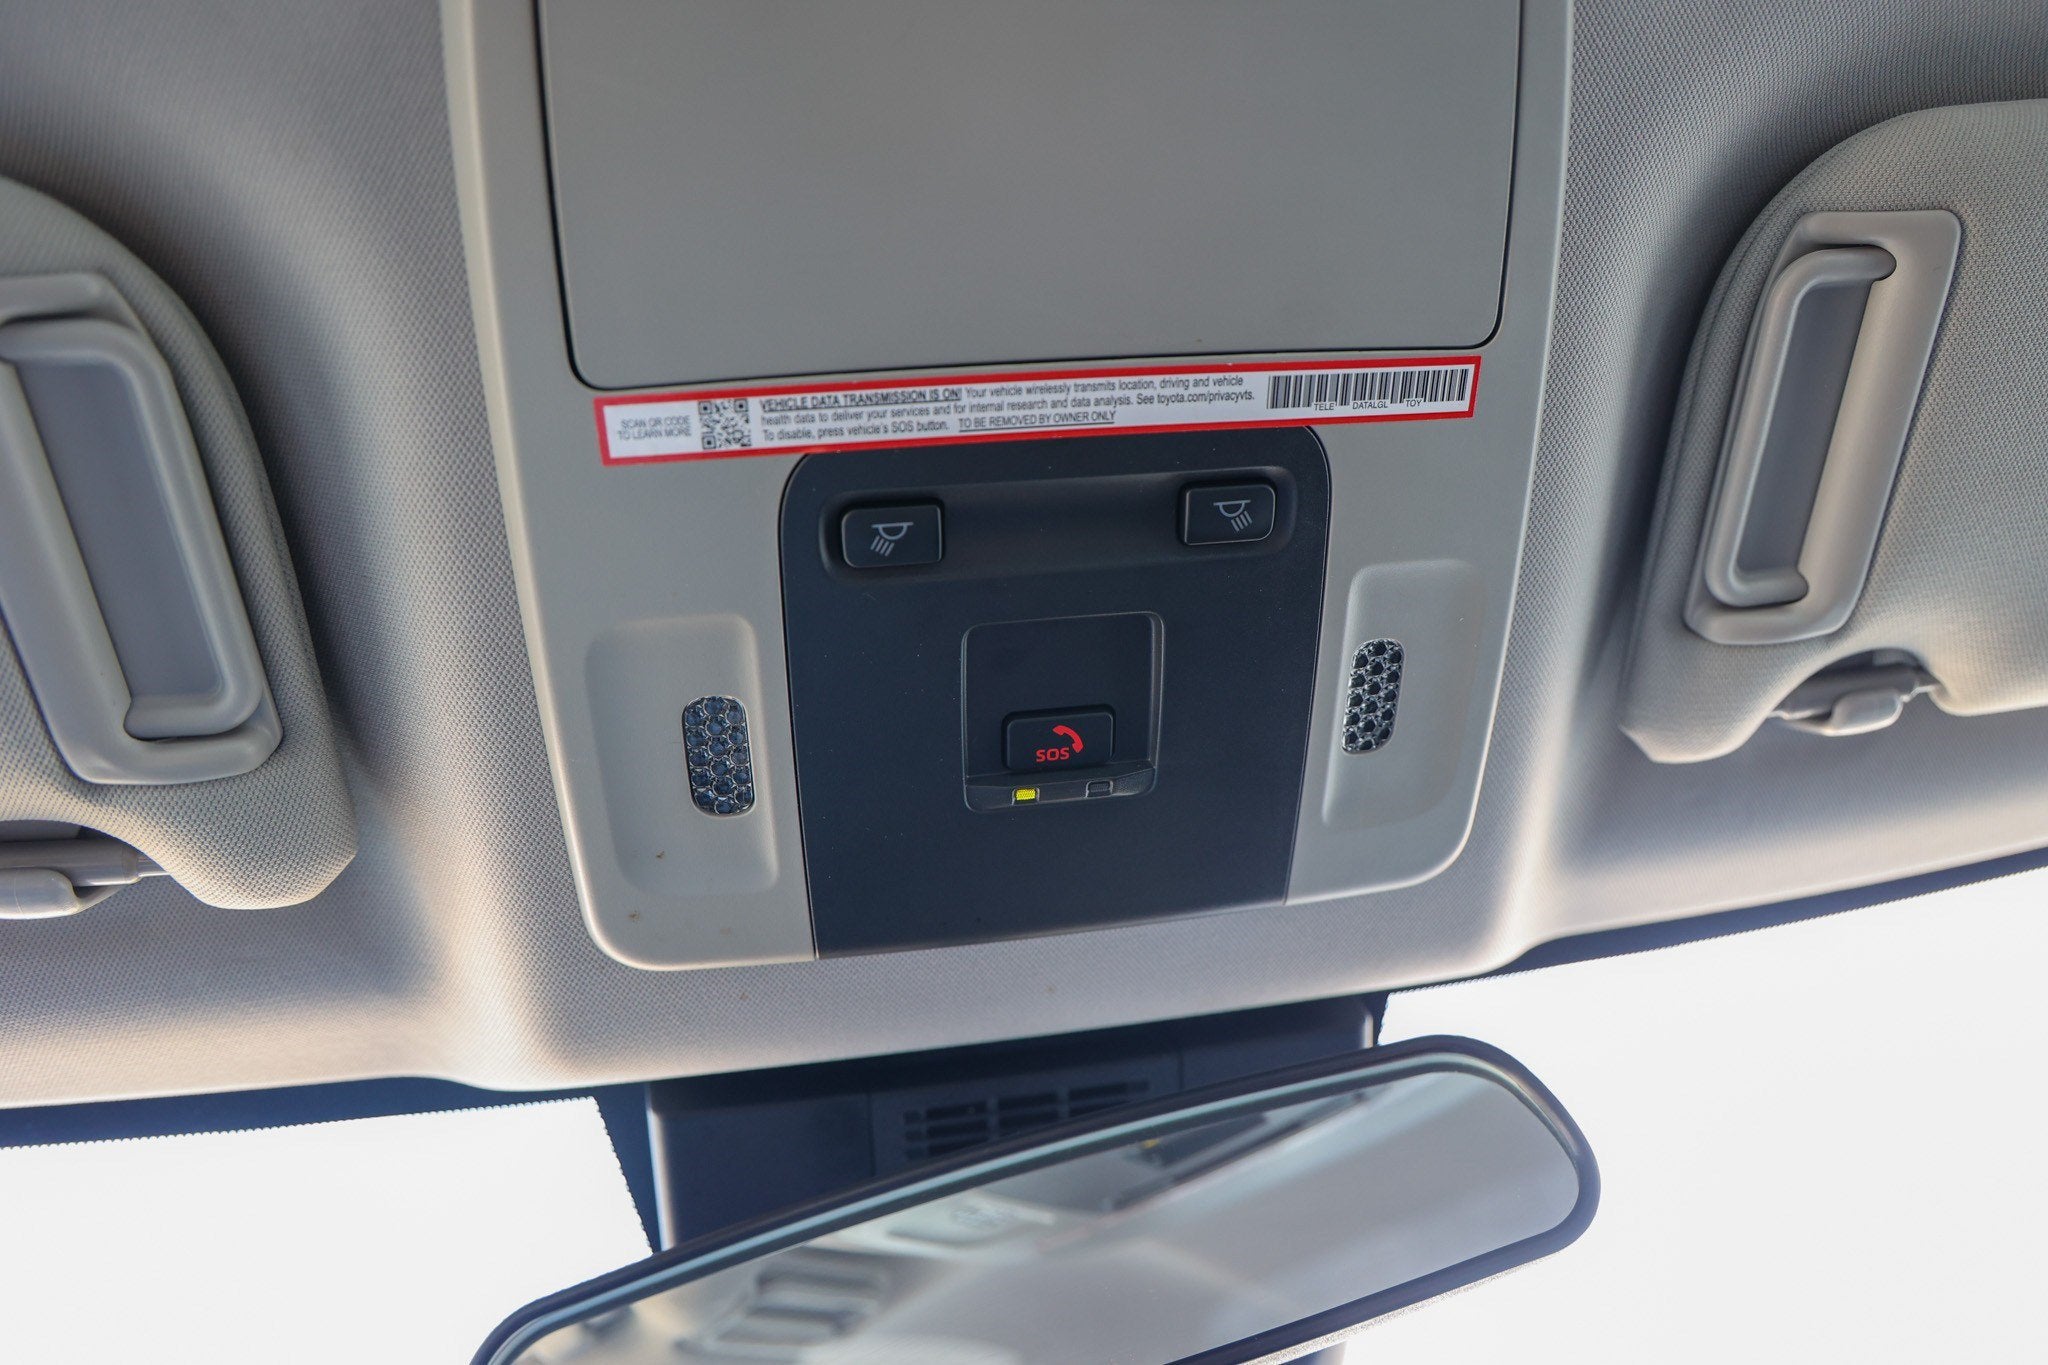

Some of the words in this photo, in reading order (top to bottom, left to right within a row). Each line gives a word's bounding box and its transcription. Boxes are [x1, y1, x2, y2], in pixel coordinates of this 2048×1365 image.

[759, 396, 809, 411] VEHICLE
[811, 395, 841, 408] DATA
[843, 389, 926, 405] TRANSMISSION
[929, 388, 939, 400] IS
[965, 386, 987, 398] Your
[990, 384, 1023, 397] vehicle
[1026, 382, 1071, 397] wirelessly
[1074, 381, 1116, 393] transmits
[1118, 378, 1157, 391] location,
[1160, 376, 1189, 391] driving
[1192, 375, 1210, 388] and
[1212, 375, 1244, 387] vehicle
[761, 412, 791, 426] health
[794, 411, 815, 424] data
[819, 411, 828, 423] to
[831, 409, 863, 422] deliver
[867, 408, 888, 422] your
[891, 405, 929, 418] services
[932, 402, 950, 415] and
[953, 402, 966, 414] for
[969, 399, 1005, 413] internal
[1007, 397, 1048, 410] research
[1051, 396, 1068, 409] and
[1071, 395, 1091, 408] data
[1094, 393, 1133, 408] analysis.
[1136, 393, 1154, 405] See
[1157, 389, 1255, 406] toyota.com/privacyvts.
[1314, 402, 1335, 411] TELE
[1352, 400, 1388, 410] DATALGL
[1405, 398, 1423, 407] TOY
[621, 417, 647, 429] SCAN
[664, 415, 691, 427] CODE
[763, 428, 774, 441] To
[777, 426, 815, 441] disable,
[817, 425, 845, 439] press
[848, 422, 888, 436] vehicle's
[891, 421, 914, 433] SOS
[917, 418, 948, 432] button.
[958, 417, 972, 429] TO
[974, 416, 986, 428] BE
[989, 413, 1038, 426] REMOVED
[1039, 412, 1051, 424] BY
[1053, 411, 1089, 423] OWNER
[1091, 410, 1117, 422] ONLY
[618, 430, 630, 441] TO
[632, 429, 663, 440] LEARN
[664, 427, 692, 438] MORE
[1035, 747, 1070, 762] SOS
